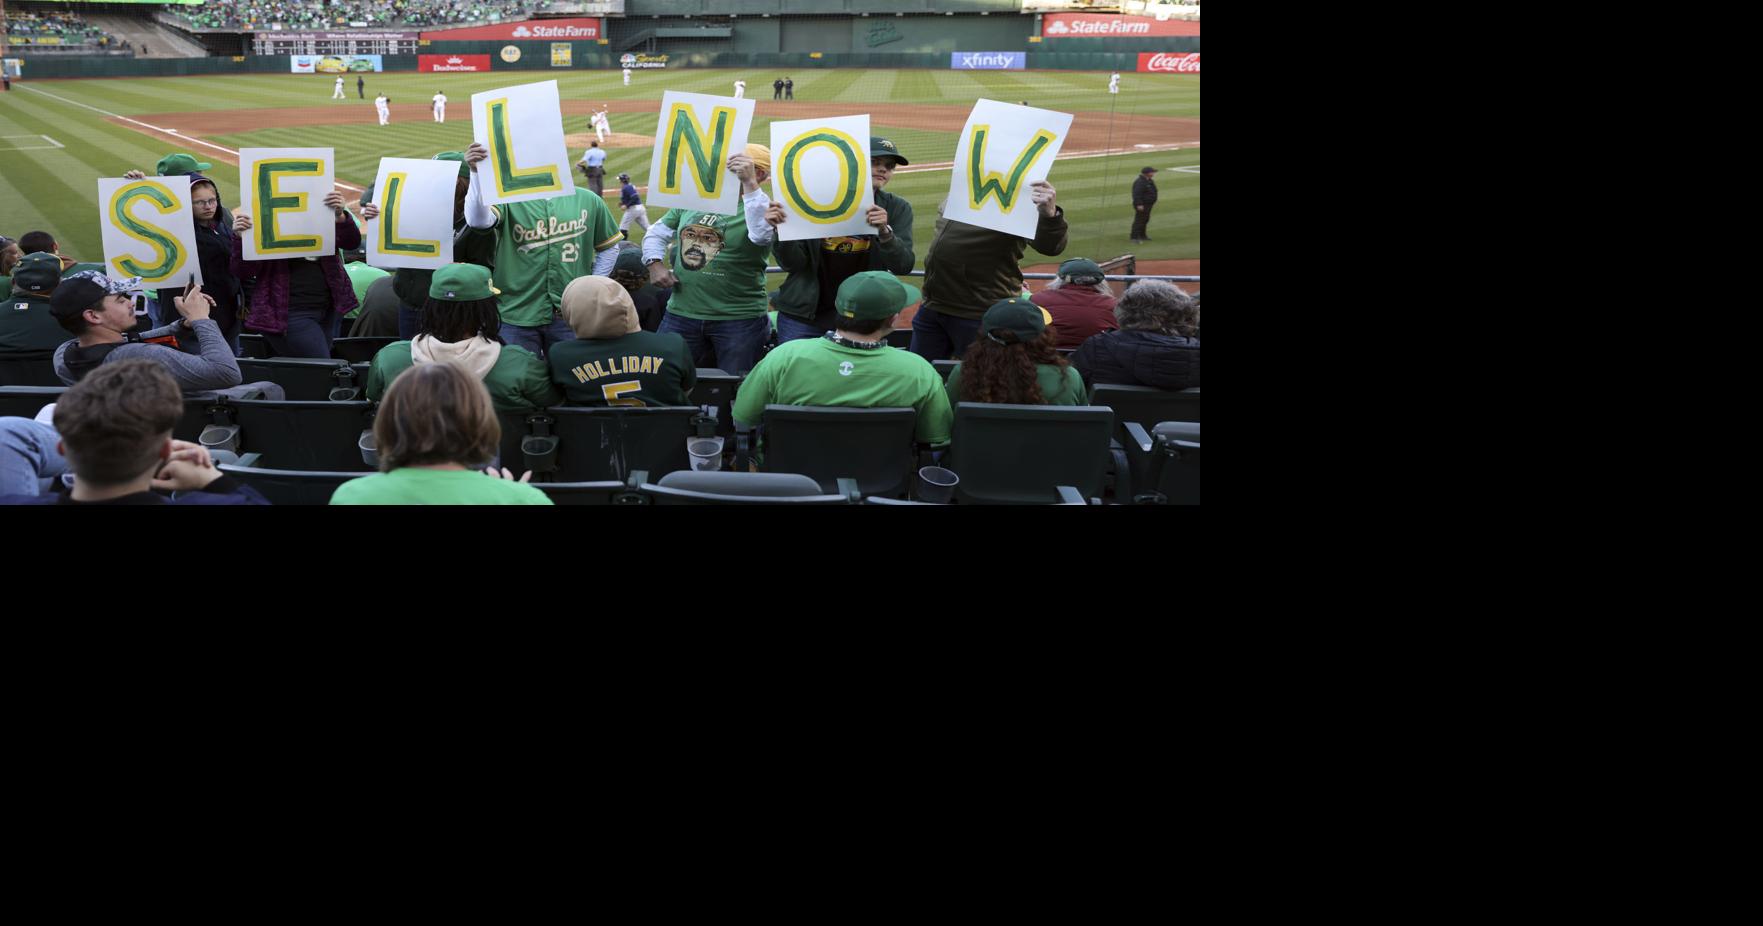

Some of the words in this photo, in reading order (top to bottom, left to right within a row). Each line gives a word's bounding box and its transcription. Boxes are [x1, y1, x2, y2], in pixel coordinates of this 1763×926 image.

[962, 53, 1014, 69] xfinity
[486, 97, 563, 198] L
[659, 102, 737, 199] N
[777, 127, 867, 225] O
[967, 124, 1057, 214] W
[108, 180, 188, 283] S
[252, 158, 325, 255] E
[377, 172, 441, 258] L
[512, 209, 588, 244] Oakland
[699, 214, 717, 226] 50
[571, 355, 664, 384] HOLLIDAY
